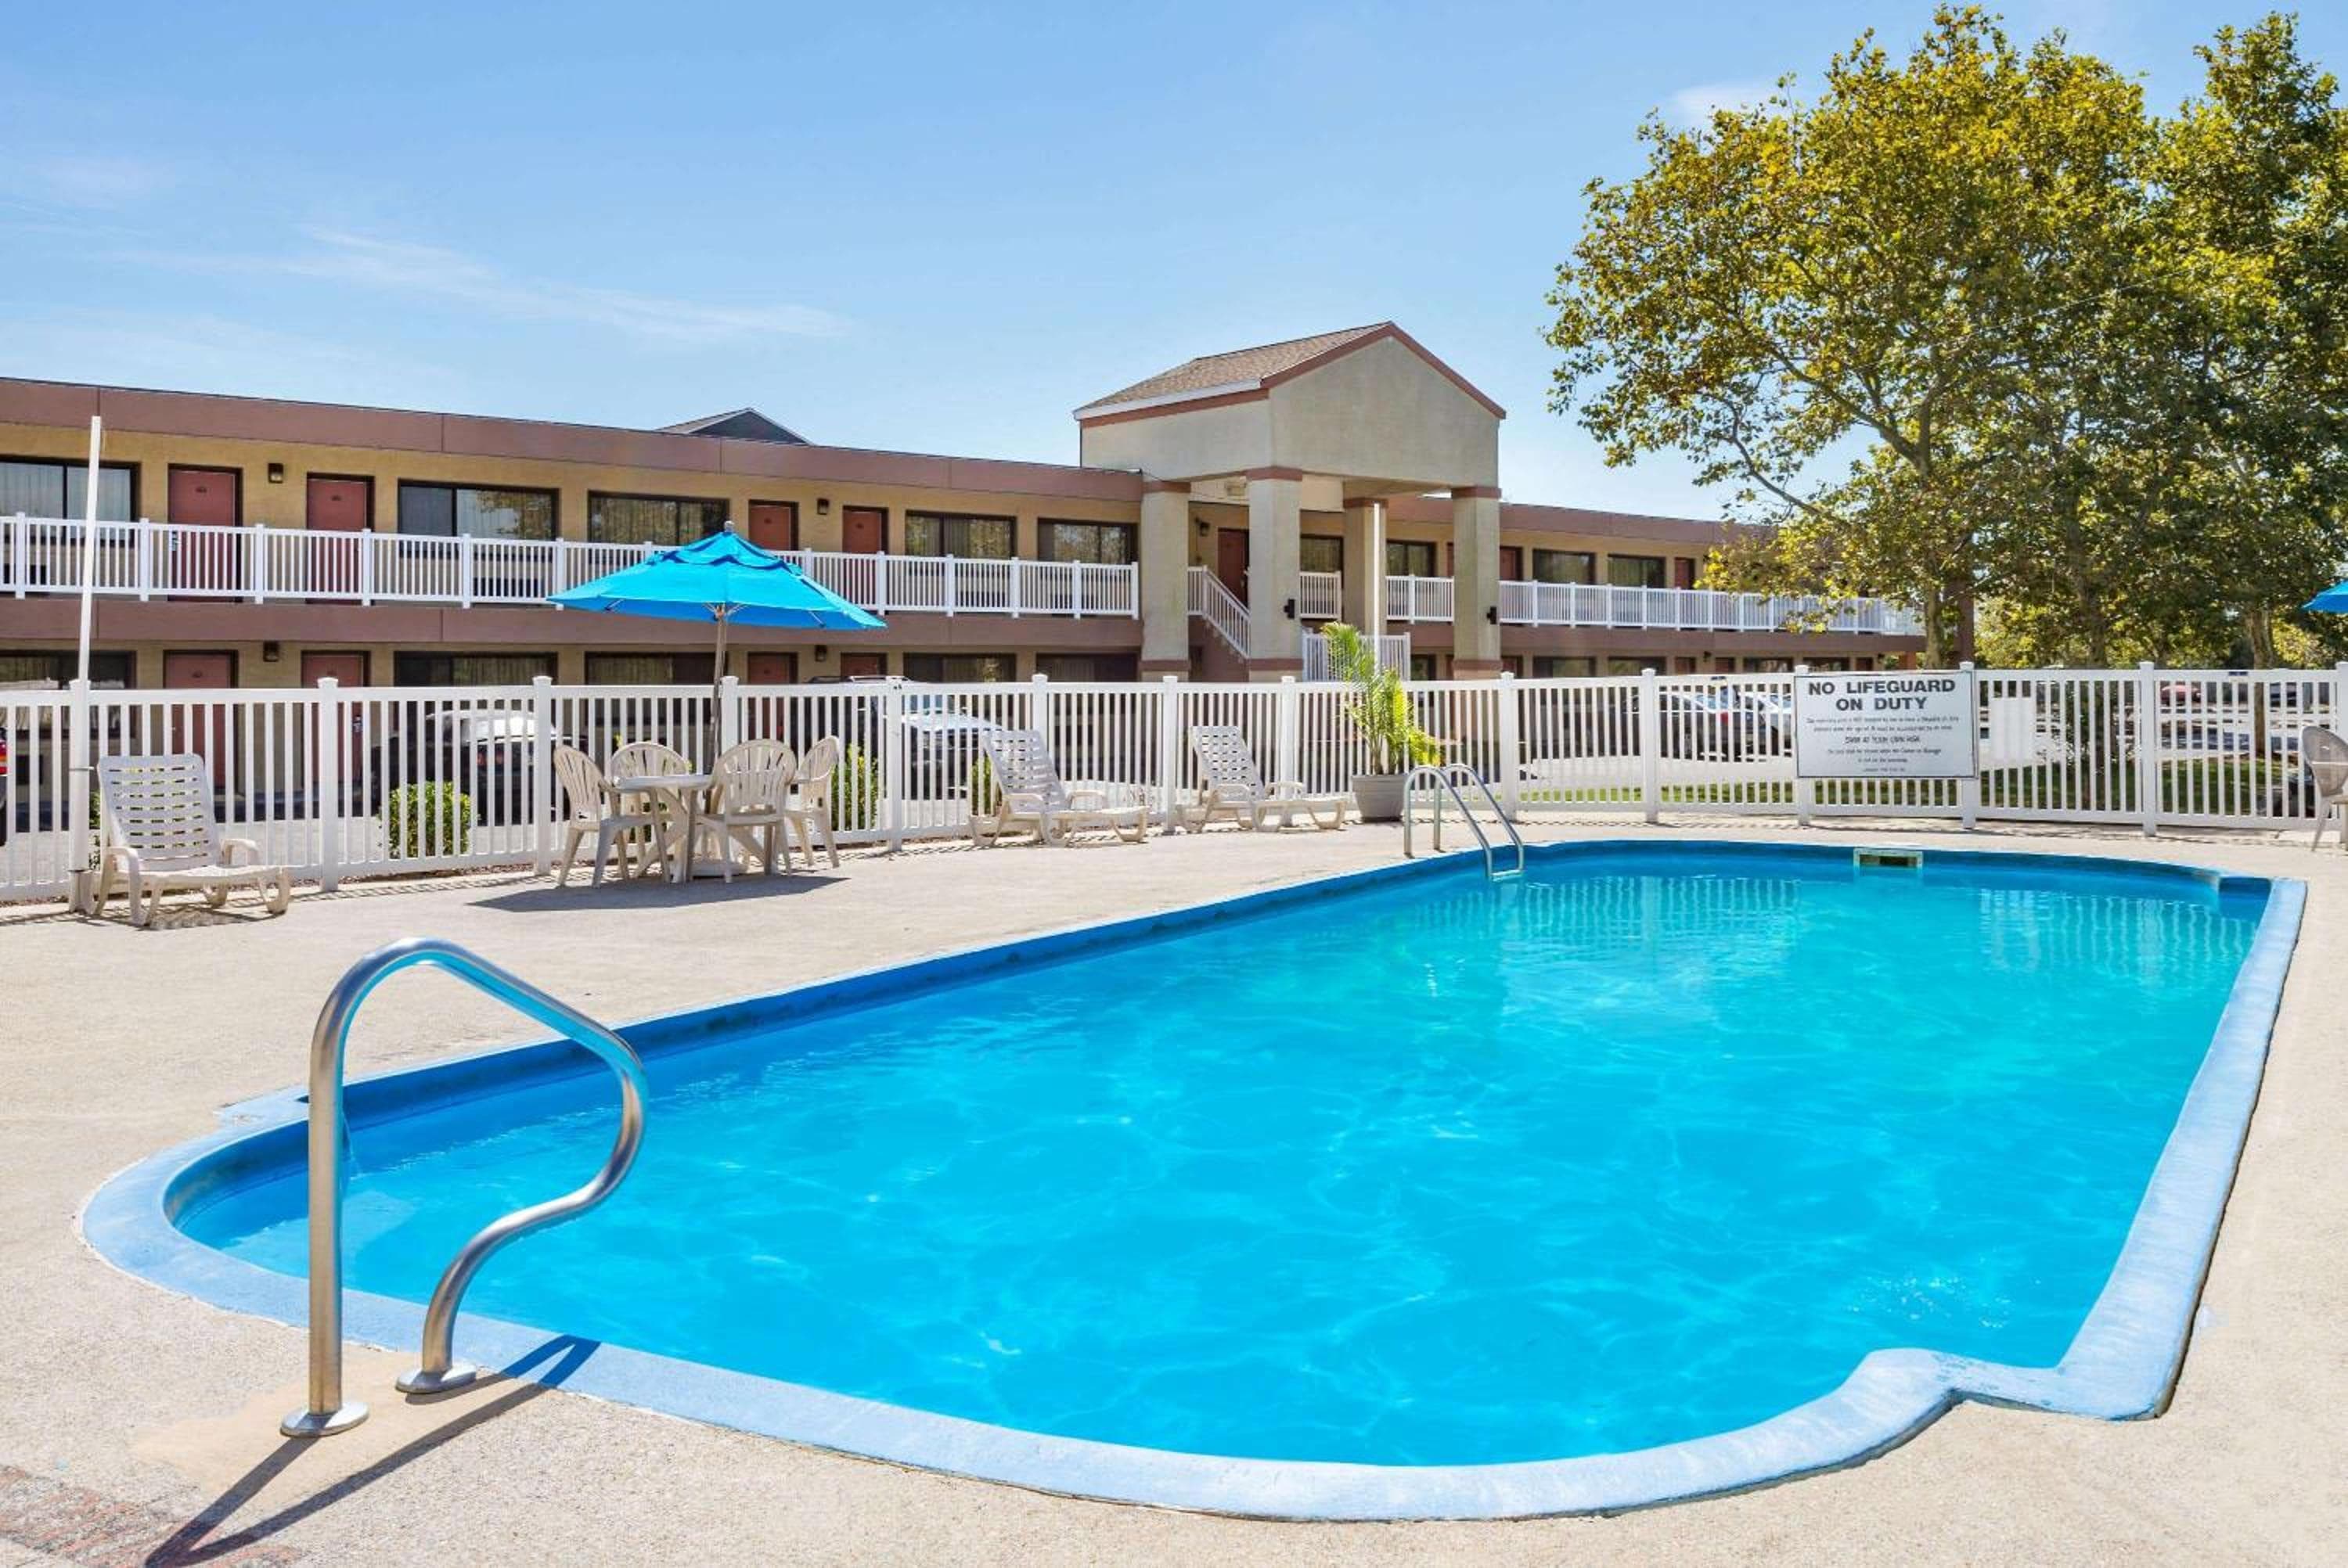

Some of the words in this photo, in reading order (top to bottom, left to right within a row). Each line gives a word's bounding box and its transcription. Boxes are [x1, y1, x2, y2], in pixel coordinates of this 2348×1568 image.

[1809, 682, 1835, 695] NO
[1846, 679, 1956, 694] LIFEGUARD
[1835, 699, 1863, 710] ON
[1874, 696, 1928, 710] DUTY
